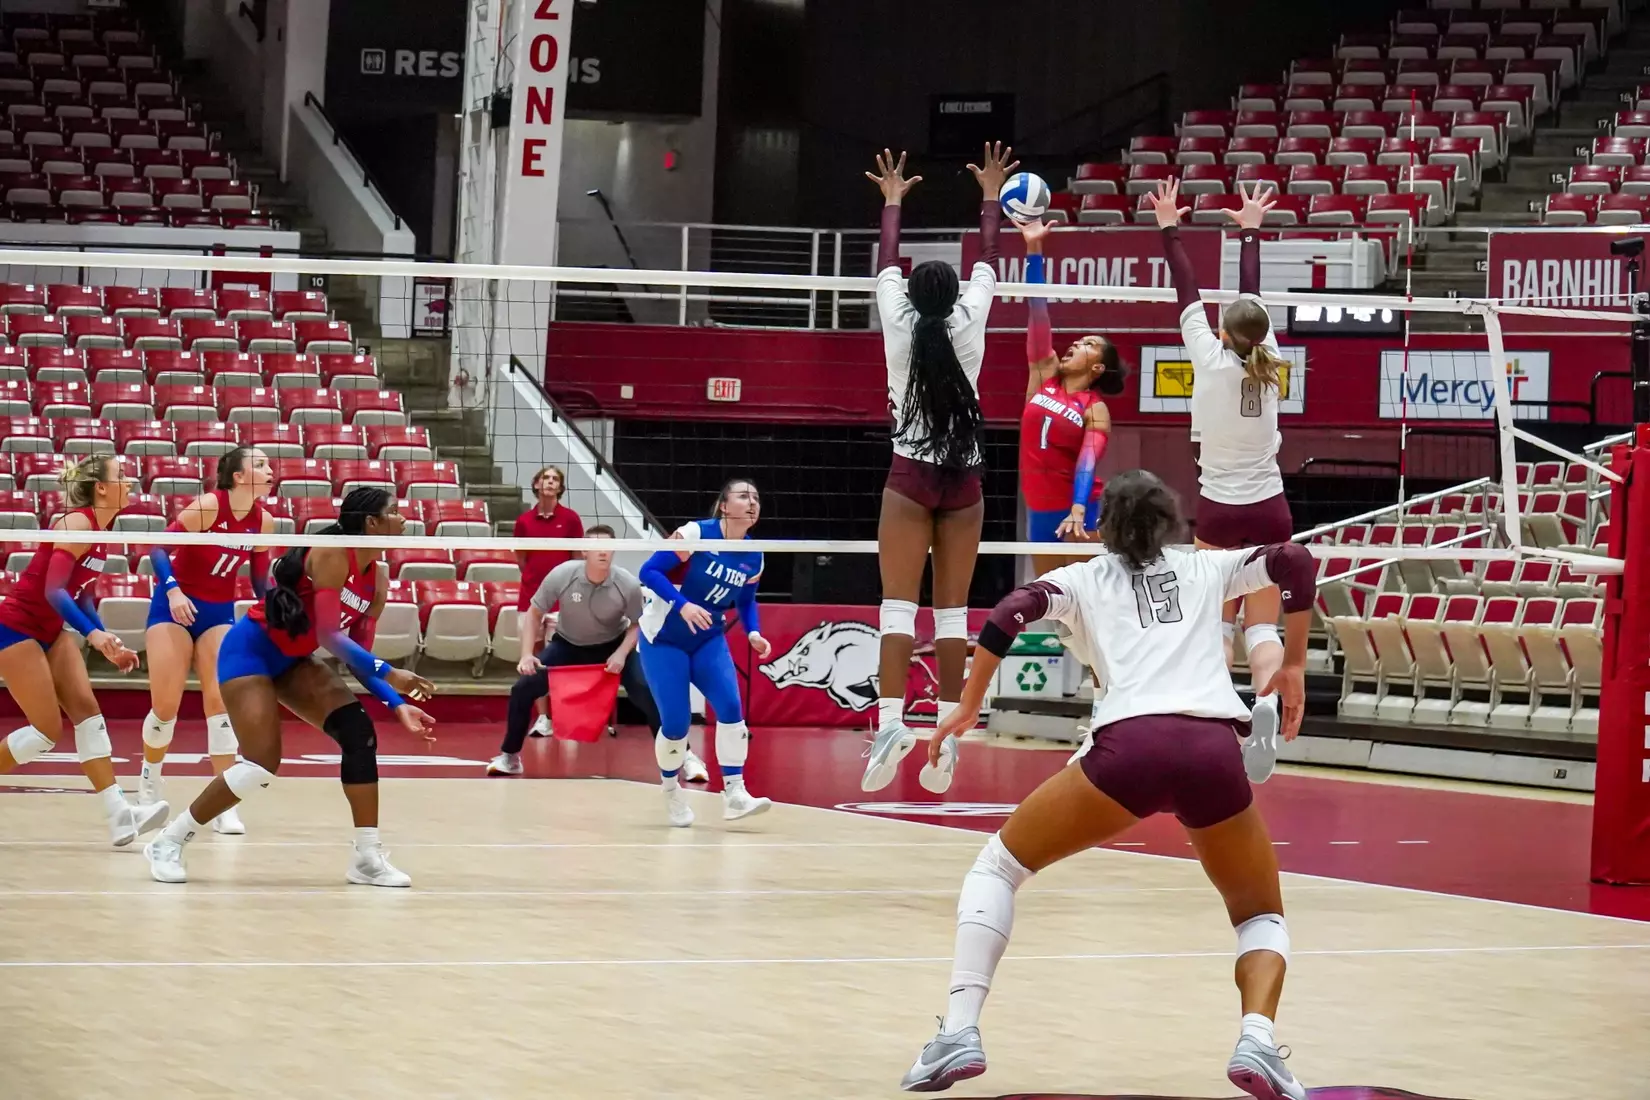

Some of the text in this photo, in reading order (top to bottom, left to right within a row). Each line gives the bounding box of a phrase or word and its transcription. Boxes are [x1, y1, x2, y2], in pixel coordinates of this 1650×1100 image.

[1598, 120, 1608, 129] 17
[312, 277, 324, 287] 10
[998, 256, 1139, 304] WLCOME
[714, 380, 737, 398] EXIT
[1240, 377, 1262, 418] 8
[1400, 371, 1496, 412] Mercy
[1040, 415, 1053, 449] 1
[210, 553, 240, 578] 11
[705, 560, 747, 587] LA TECH
[704, 583, 731, 605] 14
[1132, 570, 1183, 628] 15
